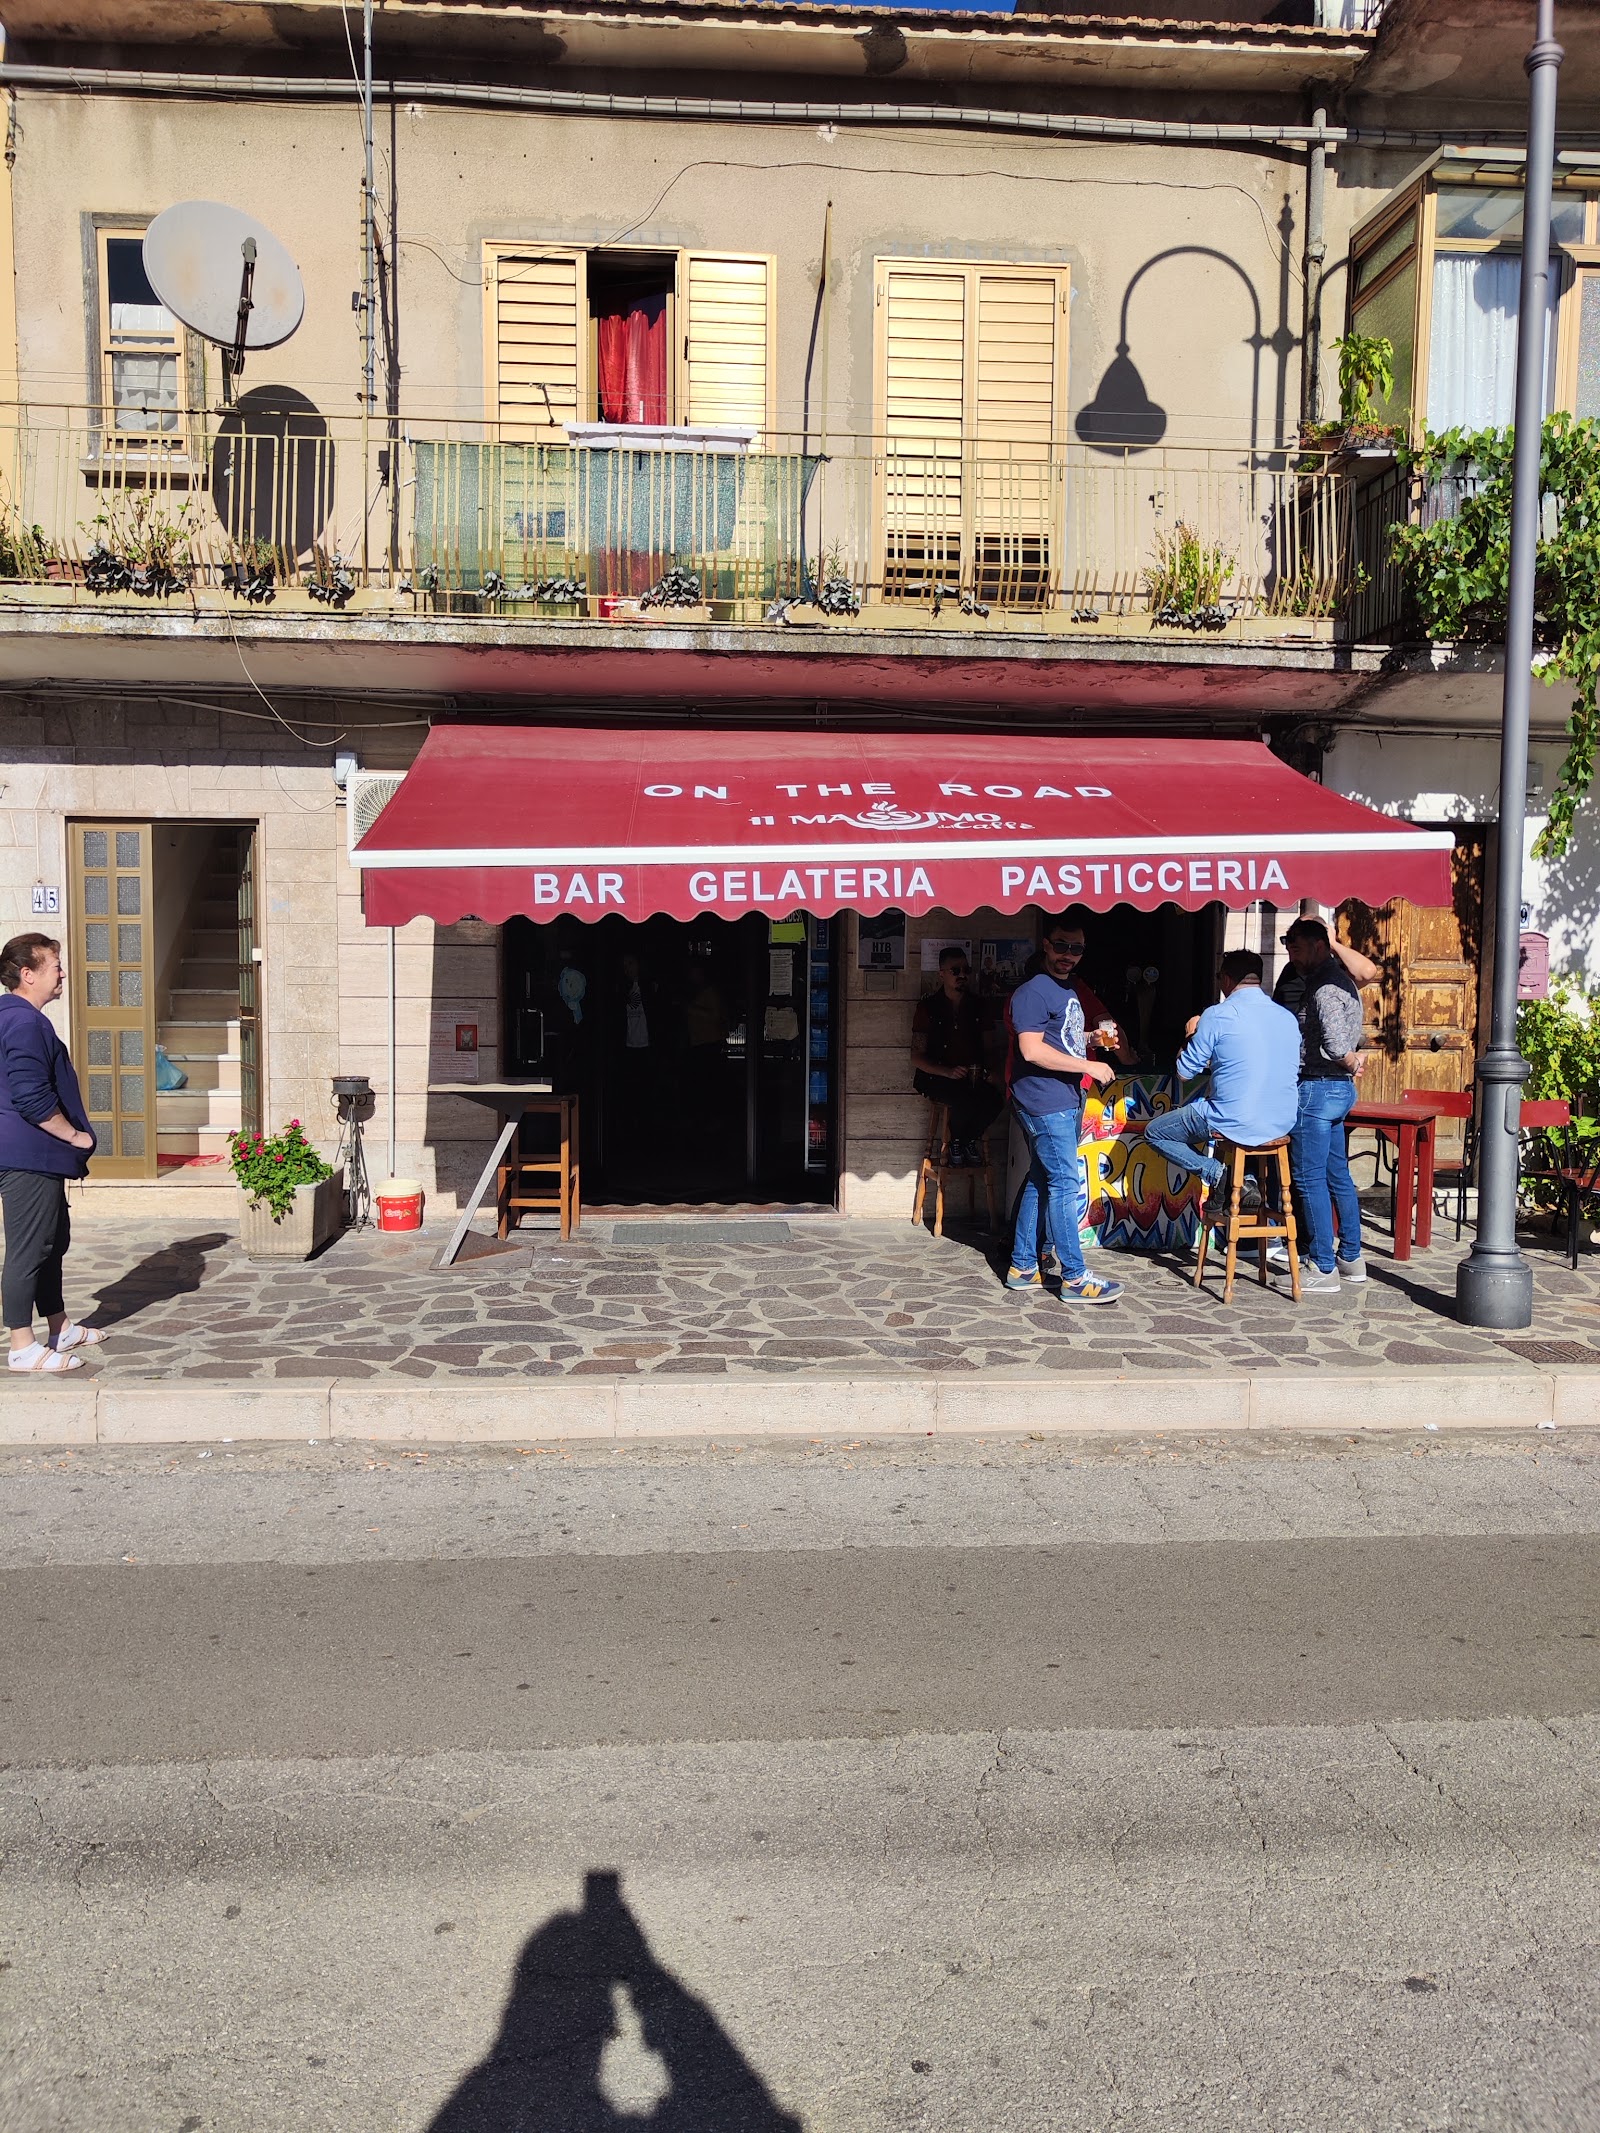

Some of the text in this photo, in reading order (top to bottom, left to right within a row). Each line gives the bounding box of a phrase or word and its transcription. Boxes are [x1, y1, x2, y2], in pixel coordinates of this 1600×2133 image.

[644, 783, 1113, 800] ON THE ROAD
[533, 859, 1290, 905] BAR GELATERIA PASTICCERIA
[34, 889, 57, 909] 45
